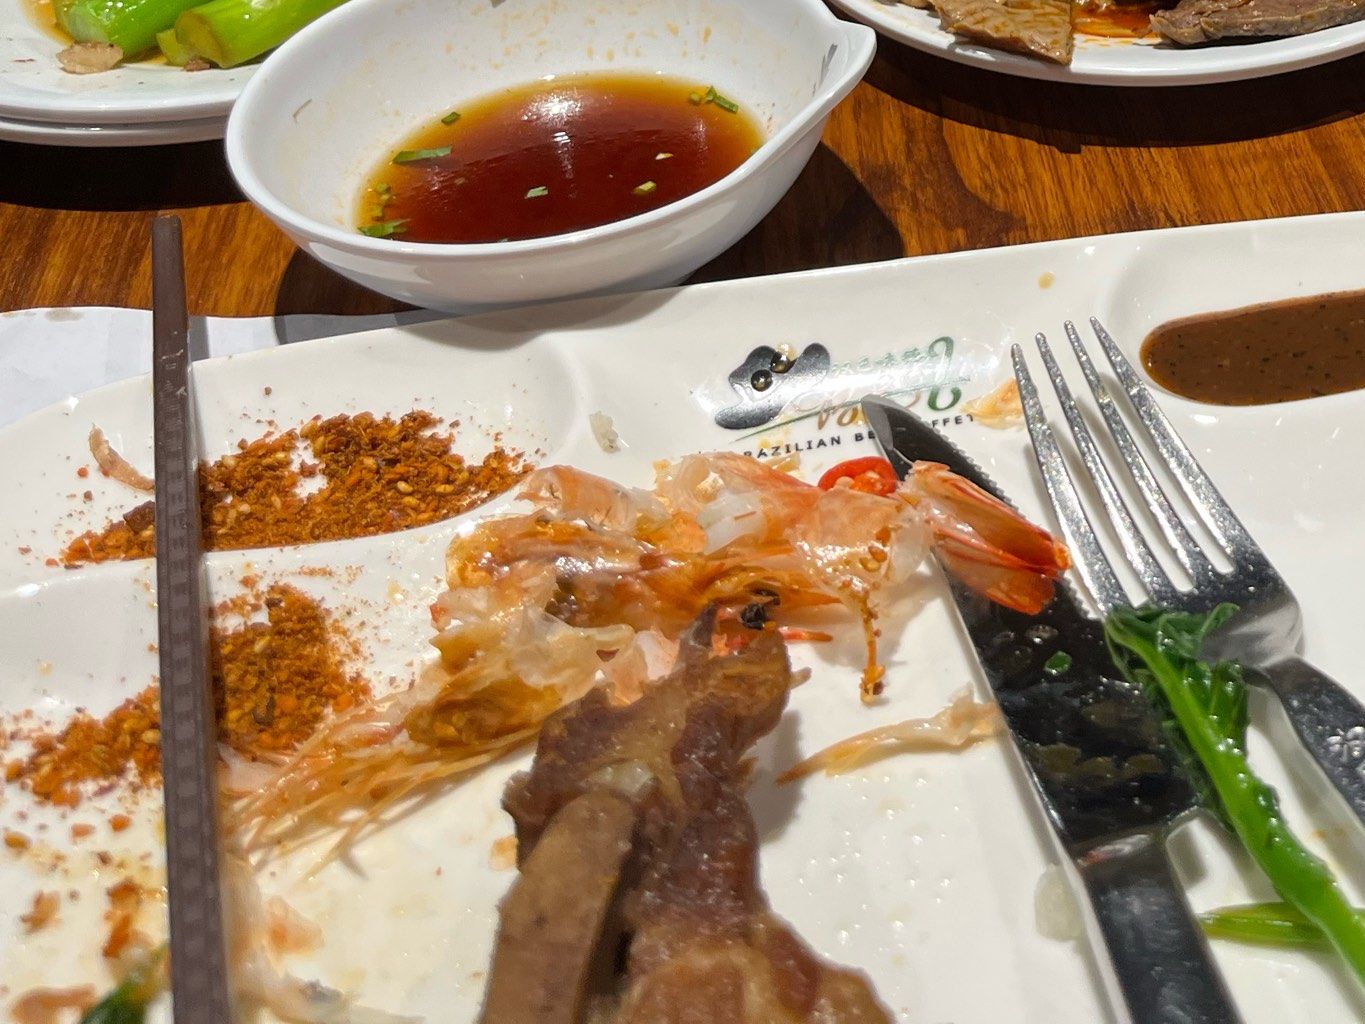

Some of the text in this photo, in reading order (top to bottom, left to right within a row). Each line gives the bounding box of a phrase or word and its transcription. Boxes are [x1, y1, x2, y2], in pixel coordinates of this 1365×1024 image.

[743, 413, 974, 459] RAZILIAN BE FFET
